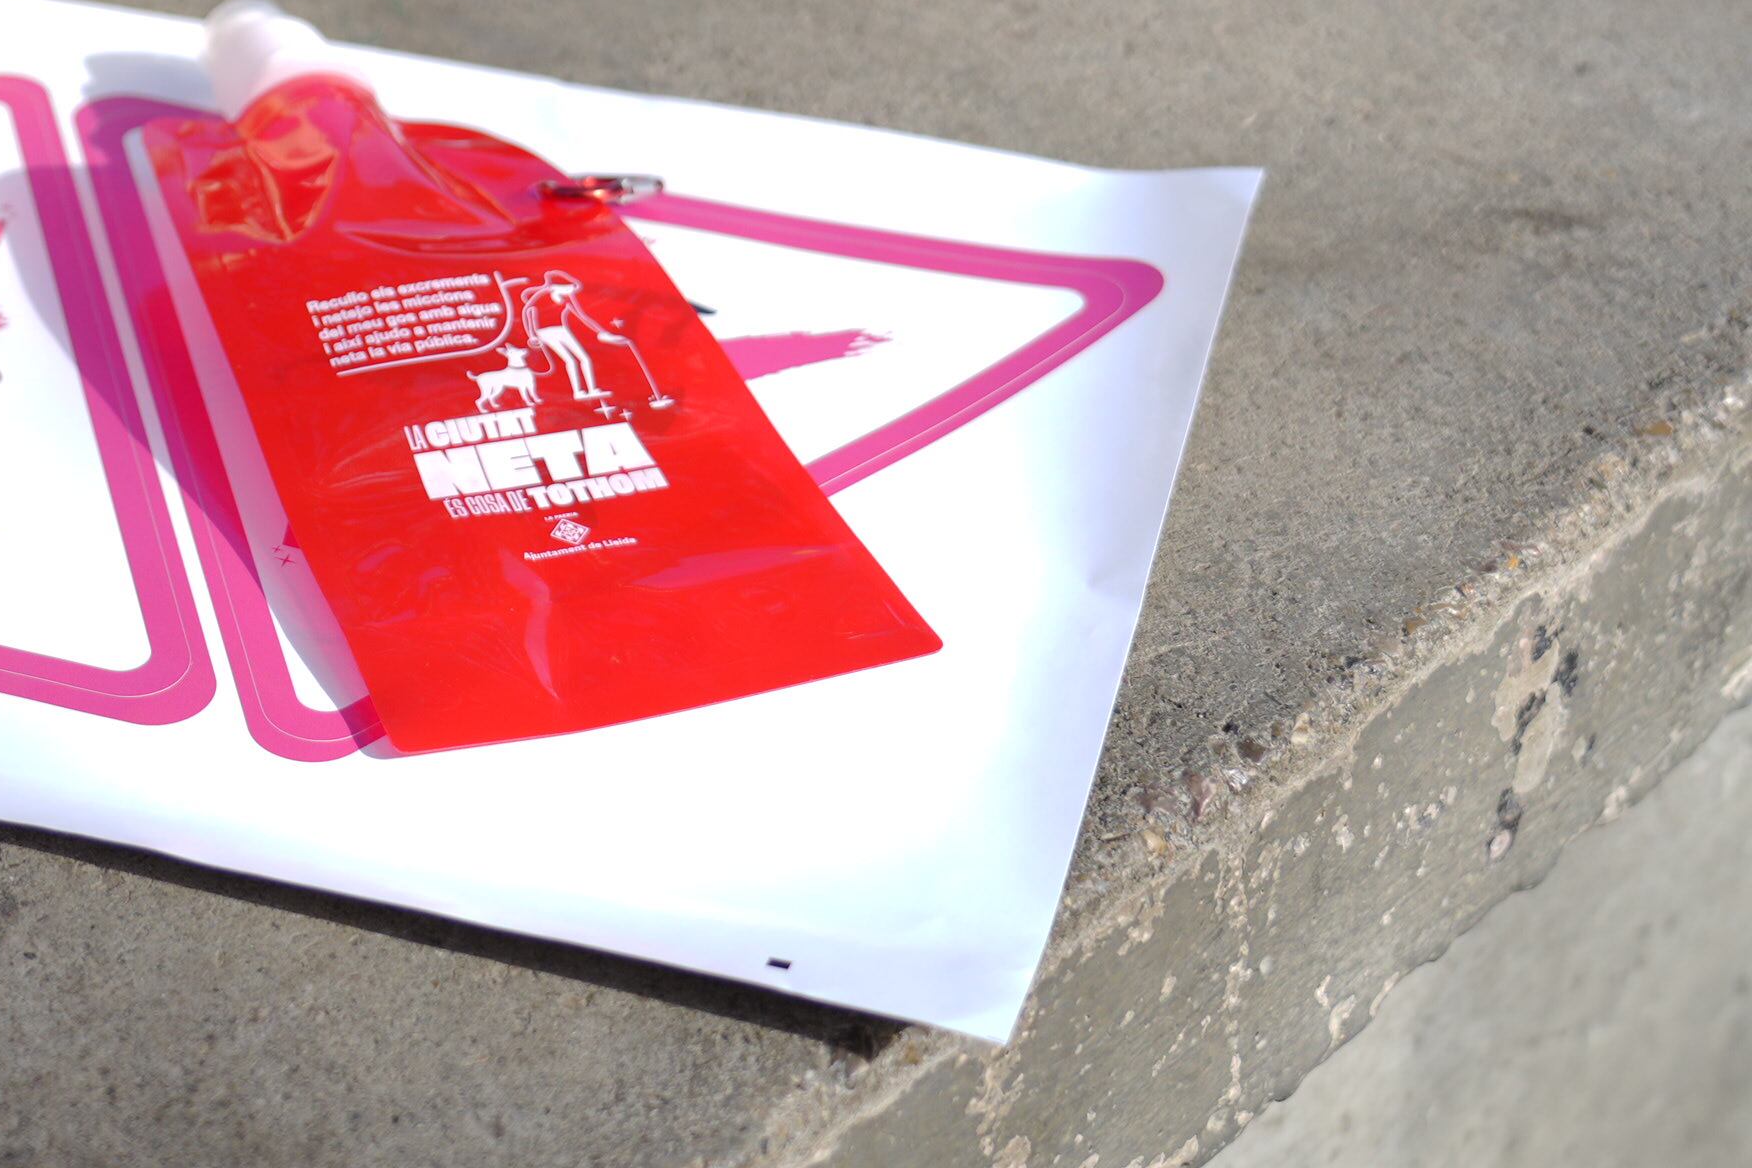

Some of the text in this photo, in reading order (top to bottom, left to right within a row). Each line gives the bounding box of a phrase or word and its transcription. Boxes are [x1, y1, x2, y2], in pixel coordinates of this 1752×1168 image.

[306, 273, 491, 313] Recullo els excrements
[321, 305, 375, 326] netejo
[402, 290, 476, 309] miccions
[318, 325, 347, 341] del
[347, 317, 385, 335] meu
[385, 312, 418, 328] gos
[418, 305, 456, 322] amb
[364, 327, 412, 345] ajudo
[426, 317, 498, 334] mantenir
[329, 351, 368, 368] neta
[403, 407, 537, 451] LA CIUTAT
[413, 422, 657, 501] NETA
[466, 492, 512, 517] COSA
[508, 489, 532, 512] DE
[526, 467, 670, 510] TOTHOM
[523, 536, 638, 561] Ajuntament de Lleida
